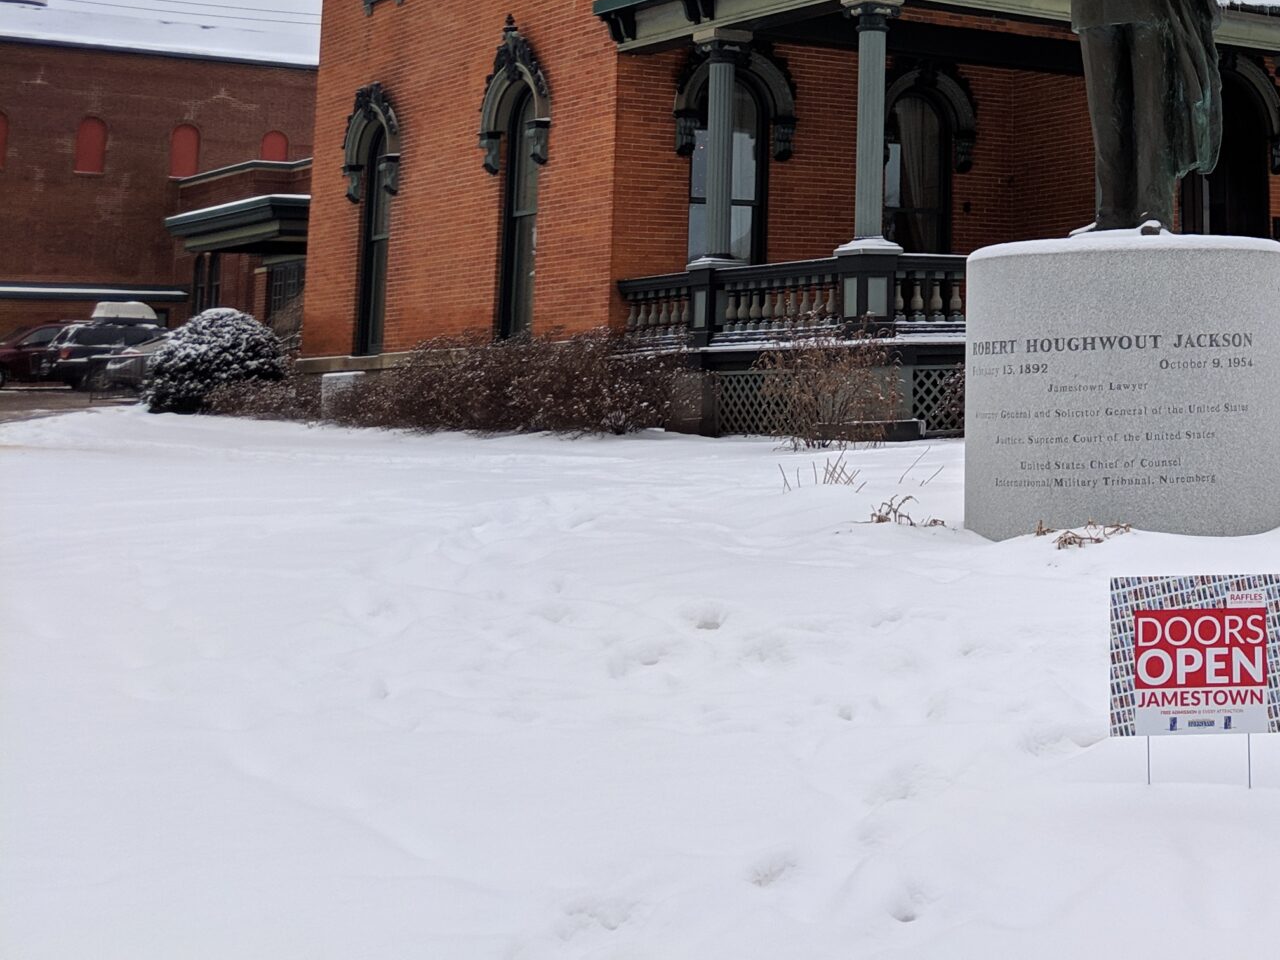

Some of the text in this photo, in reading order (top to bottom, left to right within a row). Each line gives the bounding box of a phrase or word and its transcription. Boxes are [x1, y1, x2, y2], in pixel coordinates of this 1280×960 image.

[973, 333, 1253, 356] ROBERT HOUGHWOUT JACKSON
[1019, 363, 1048, 375] 1892
[1159, 358, 1208, 370] October
[1228, 356, 1253, 368] 1954
[1047, 382, 1149, 393] Jamestown Lawyer
[1034, 409, 1051, 419] and
[1054, 408, 1100, 419] Solicitor
[1105, 406, 1147, 417] General
[1151, 406, 1163, 415] of
[1167, 405, 1184, 415] the
[1188, 404, 1221, 414] United
[1223, 402, 1249, 413] States
[1027, 435, 1069, 447] Supreme
[1072, 433, 1103, 444] Court
[1107, 432, 1118, 443] of
[1124, 433, 1140, 442] the
[1145, 431, 1181, 441] United
[1185, 430, 1216, 440] States
[1020, 457, 1182, 471] United States Chief of Counsel
[1053, 476, 1098, 489] Military
[1159, 473, 1217, 486] Nuremberg
[1230, 593, 1263, 601] RAFFLES
[1138, 614, 1264, 647] DOORS
[1136, 646, 1264, 686] OPEN
[1138, 688, 1264, 708] JAMESTOWN
